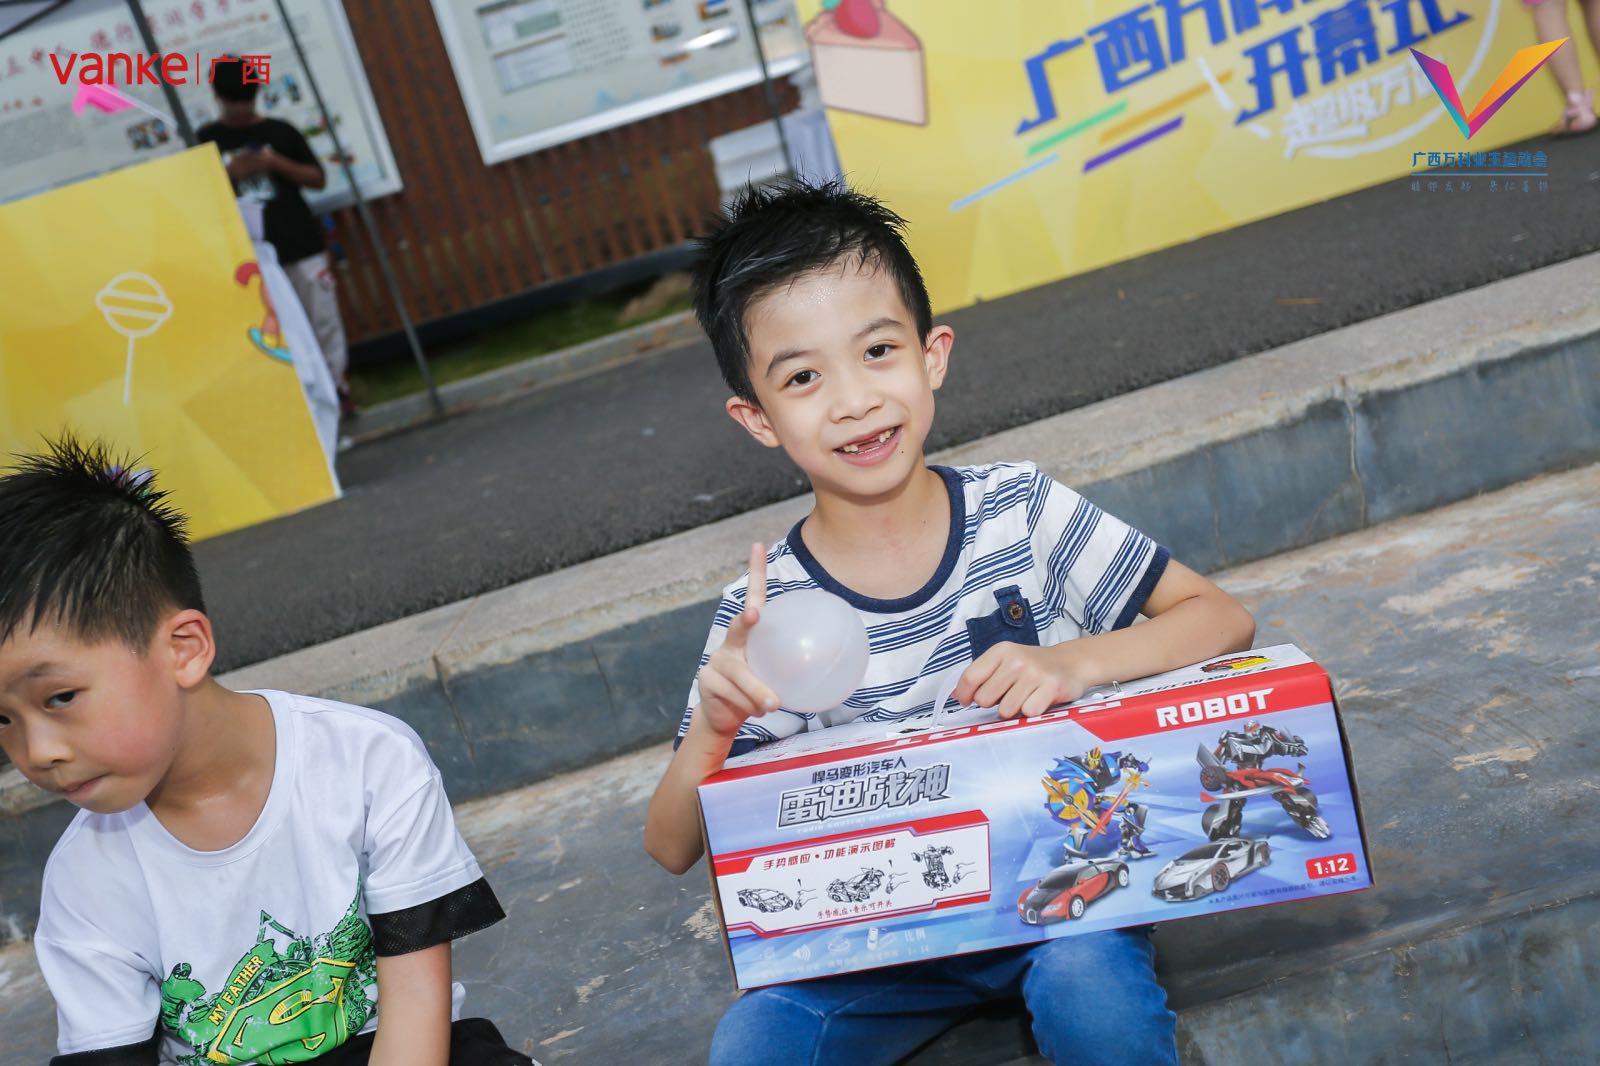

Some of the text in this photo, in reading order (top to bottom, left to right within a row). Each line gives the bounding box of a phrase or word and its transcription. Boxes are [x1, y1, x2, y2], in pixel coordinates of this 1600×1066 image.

[1156, 688, 1275, 728] ROBOT
[811, 756, 907, 785] 悍马变形汽车人
[777, 763, 952, 828] 雷迪战神
[1314, 857, 1350, 875] 1:12
[208, 955, 265, 1026] MY FATHER
